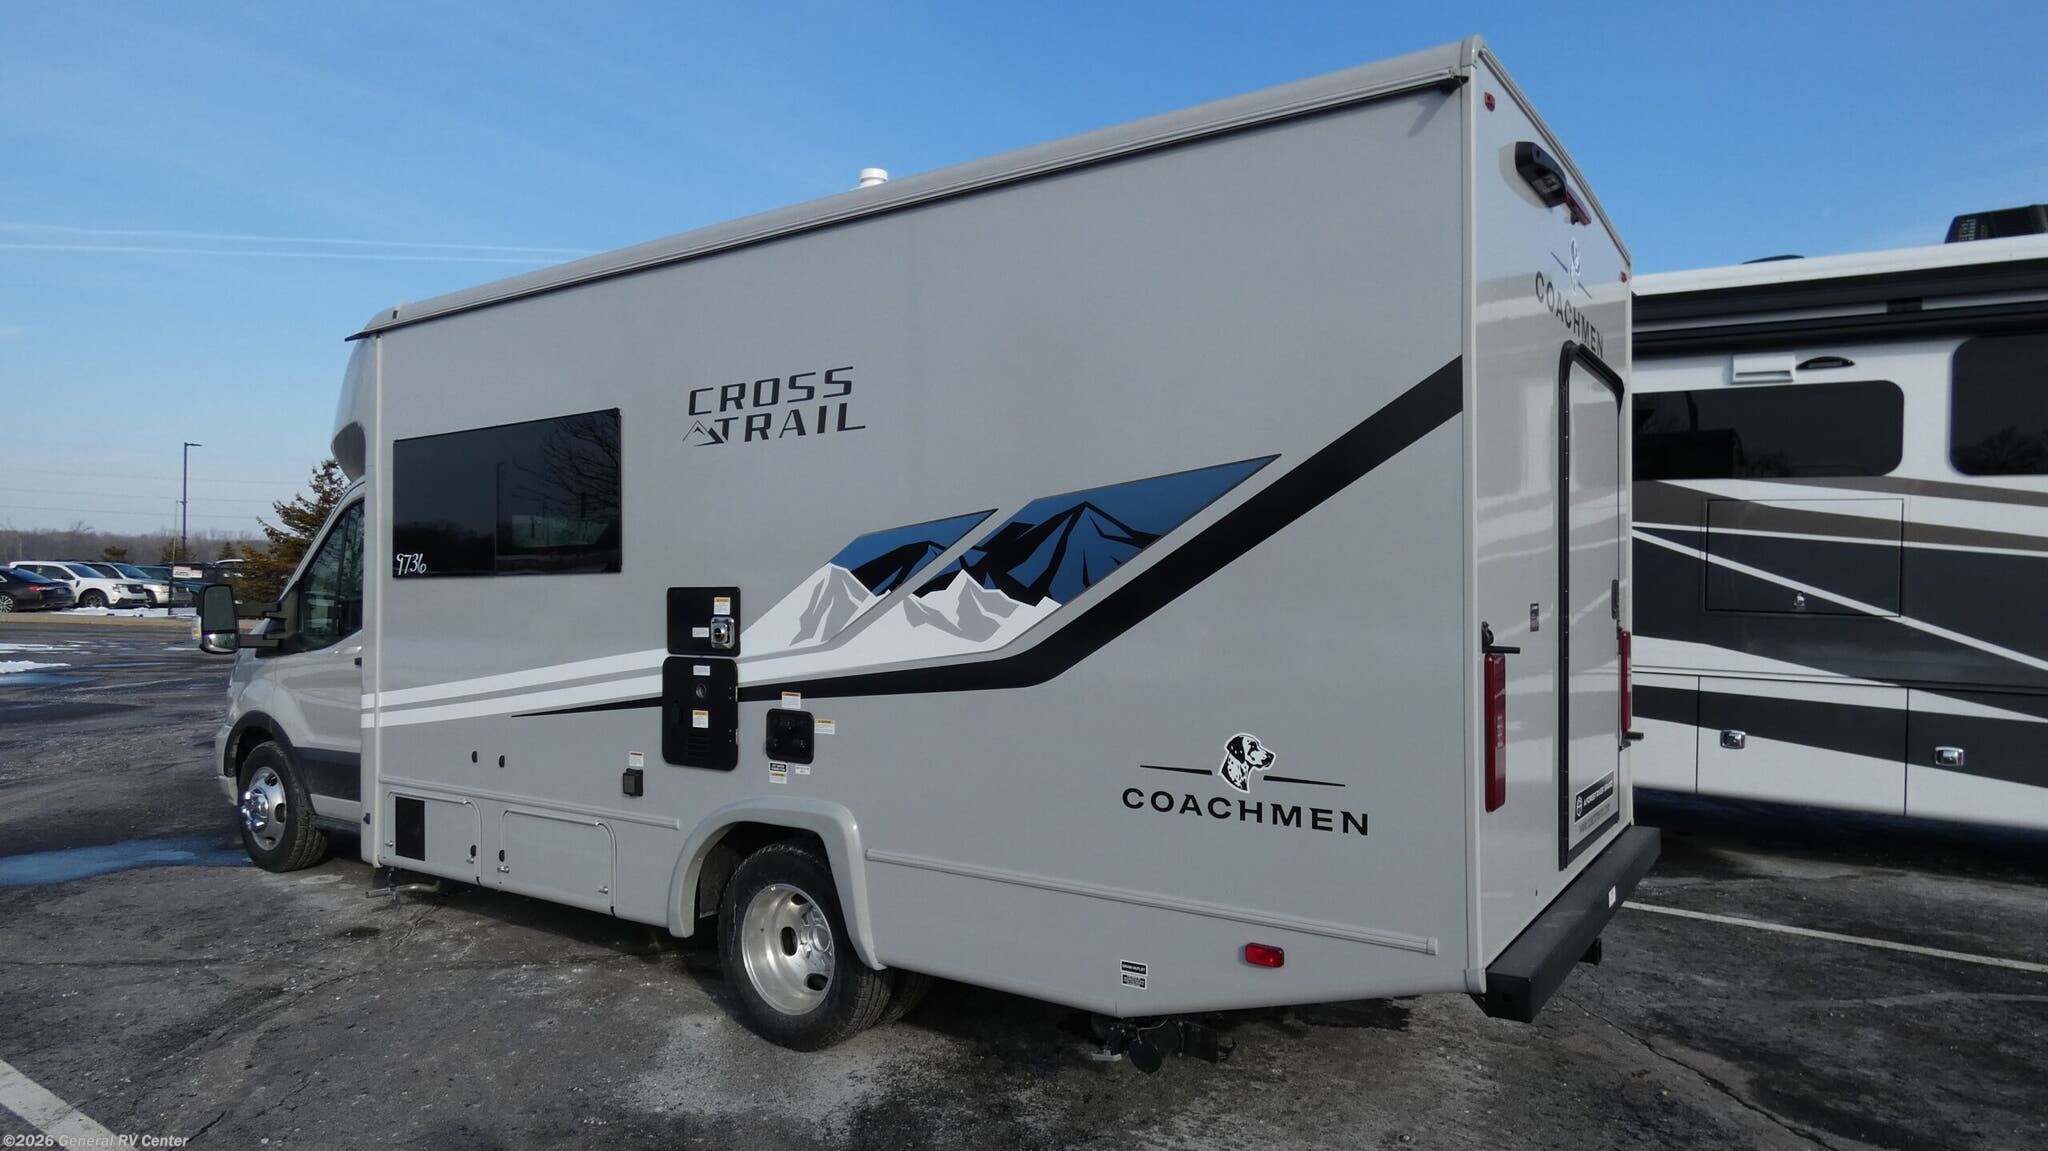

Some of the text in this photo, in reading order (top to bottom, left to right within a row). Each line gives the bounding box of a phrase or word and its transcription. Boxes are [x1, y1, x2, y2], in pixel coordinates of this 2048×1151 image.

[1535, 271, 1604, 359] COACHMEN
[688, 366, 854, 416] CROSS
[714, 402, 867, 443] TRAIL
[396, 552, 428, 576] 9736
[1122, 787, 1369, 836] COACHMEN
